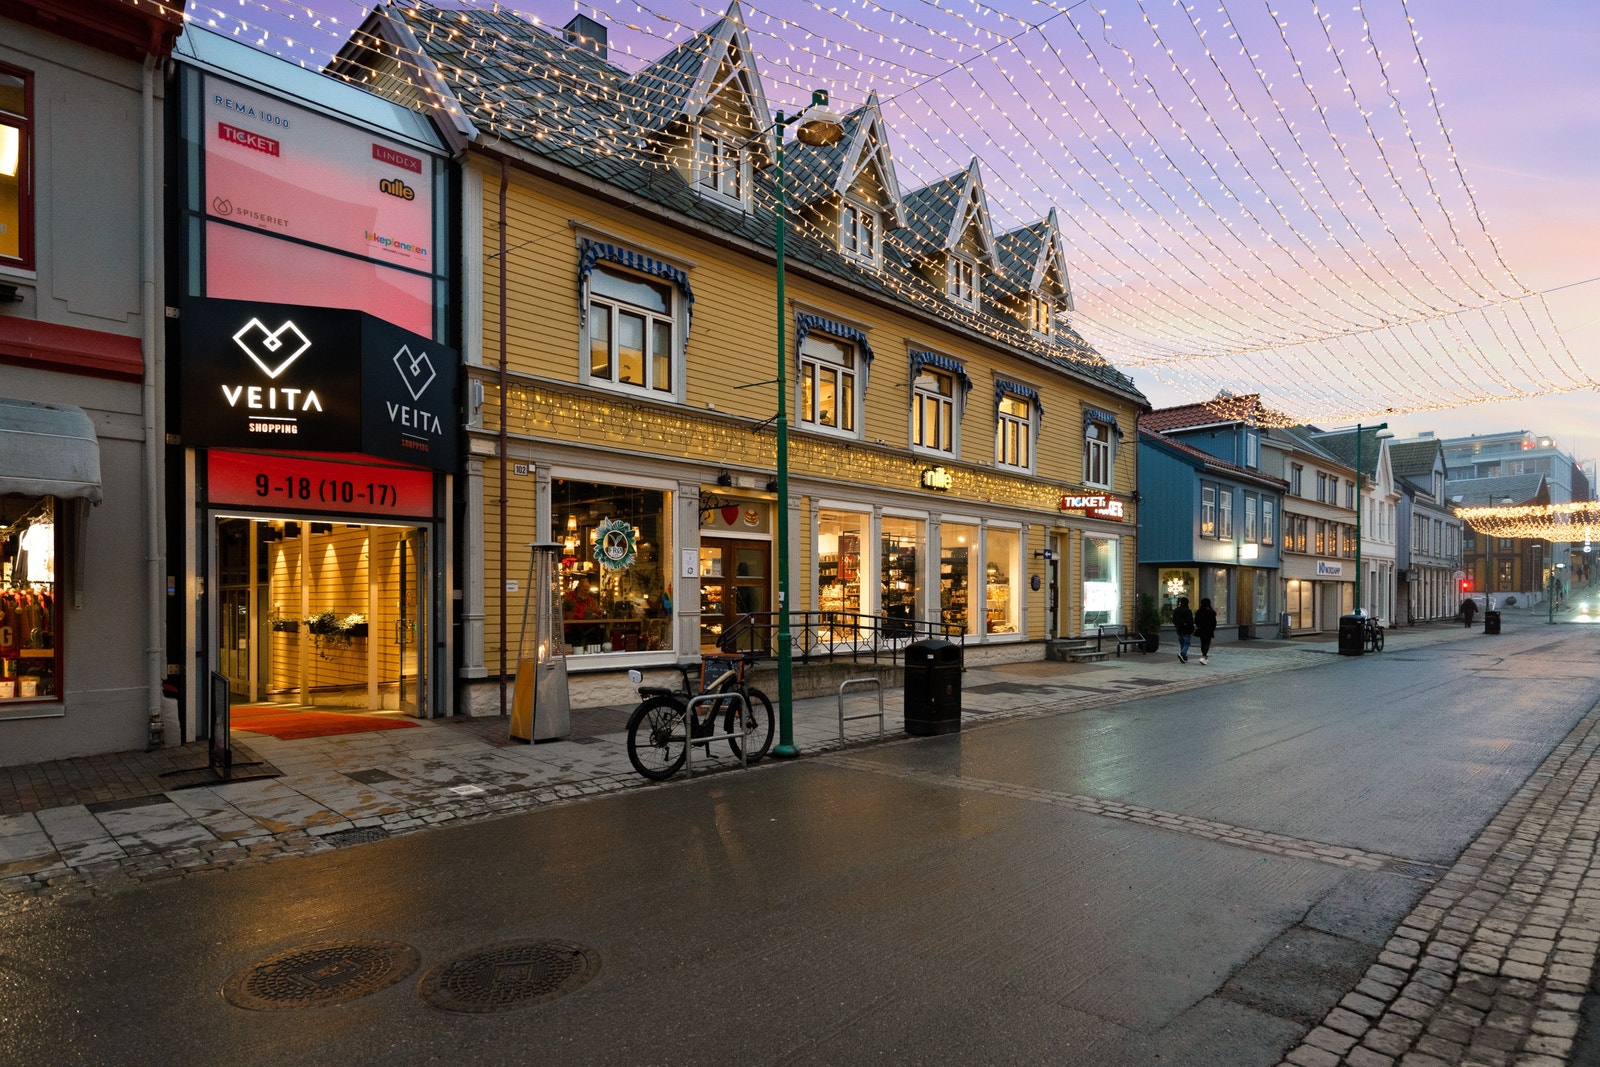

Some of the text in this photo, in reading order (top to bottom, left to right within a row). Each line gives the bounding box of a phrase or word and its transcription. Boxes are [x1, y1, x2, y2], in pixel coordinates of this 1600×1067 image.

[215, 95, 290, 128] REMA 1000
[223, 126, 275, 152] TICKET
[376, 148, 417, 169] LINDEX
[380, 179, 414, 200] nille
[236, 207, 289, 227] SPISERIET
[365, 230, 427, 255] lekeplaneten
[221, 384, 323, 412] VEITA
[248, 422, 298, 434] SHOPPING
[386, 401, 442, 435] VEITA
[515, 465, 526, 474] 102
[926, 467, 953, 488] nille
[319, 479, 397, 507] (10-17)
[1064, 496, 1105, 507] TICKET
